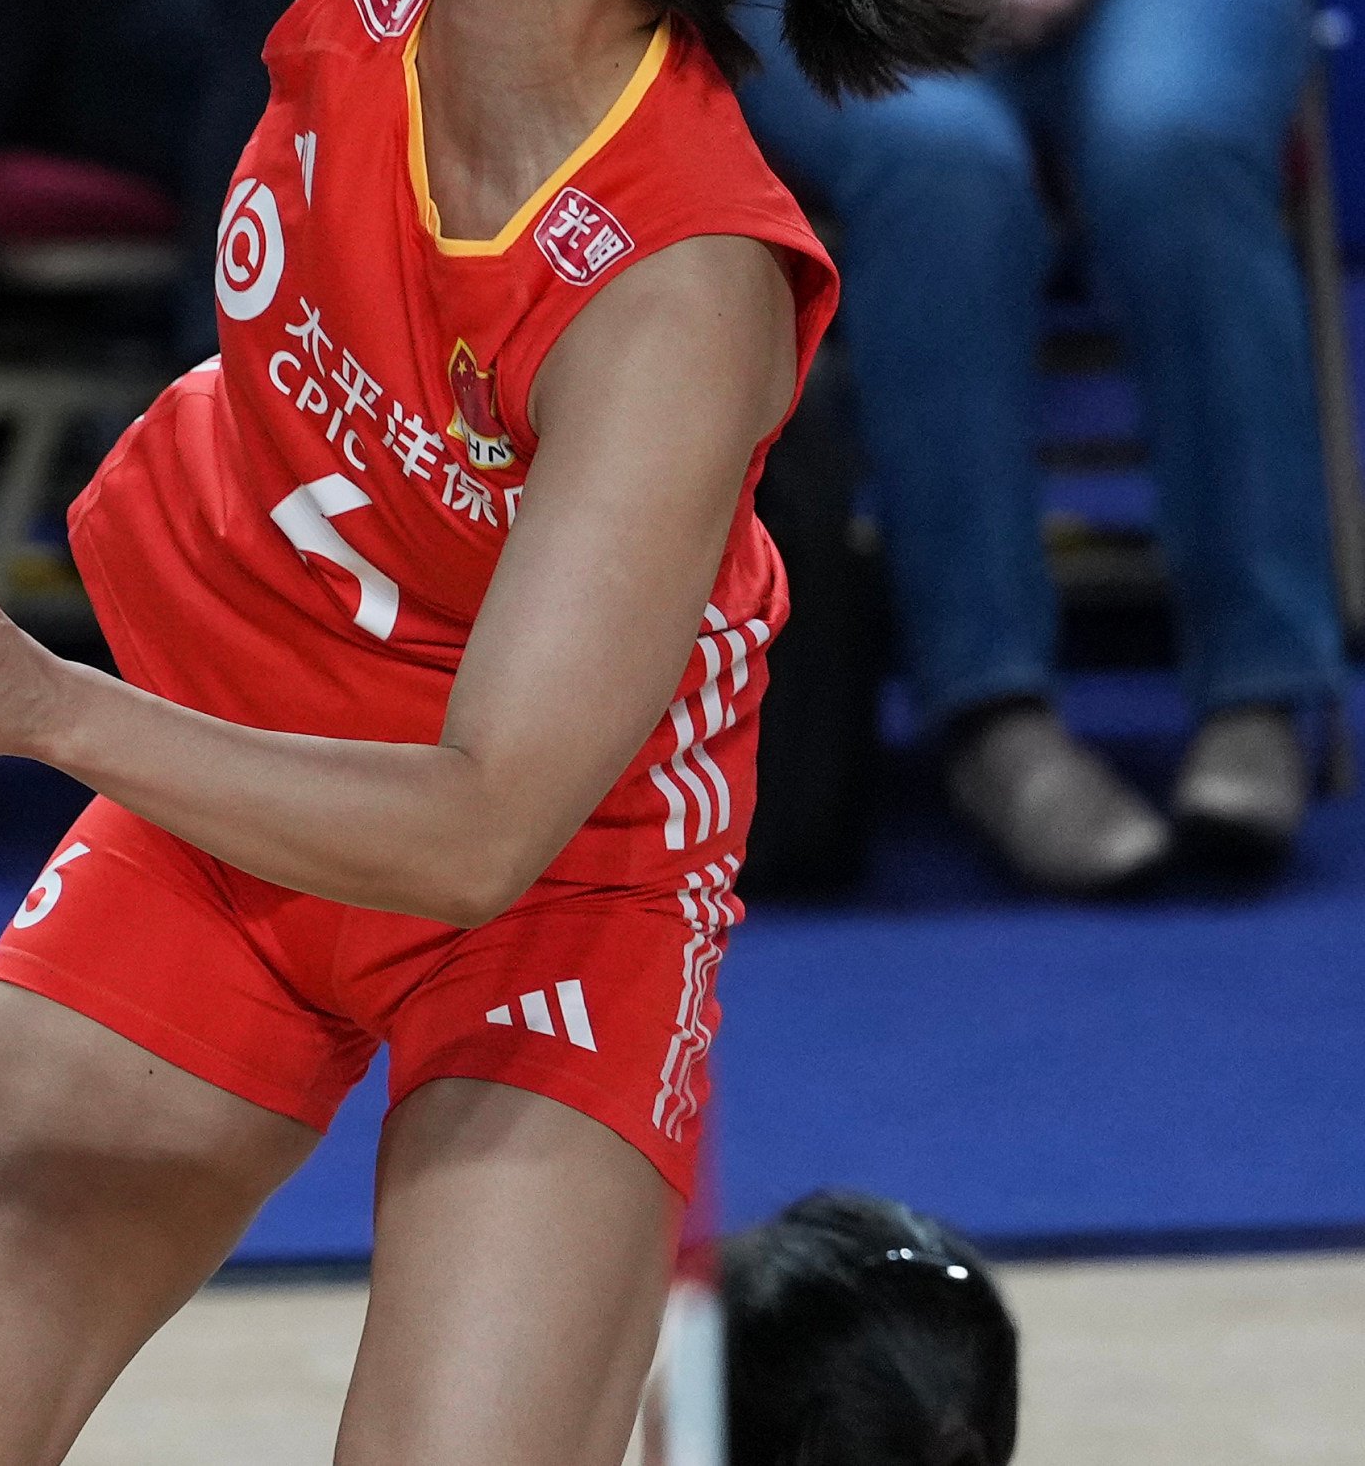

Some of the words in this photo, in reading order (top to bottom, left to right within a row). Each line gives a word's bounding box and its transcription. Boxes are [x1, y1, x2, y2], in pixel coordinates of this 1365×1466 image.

[268, 350, 367, 471] CPIC
[284, 296, 524, 529] 太平洋保
[13, 841, 91, 930] 6
